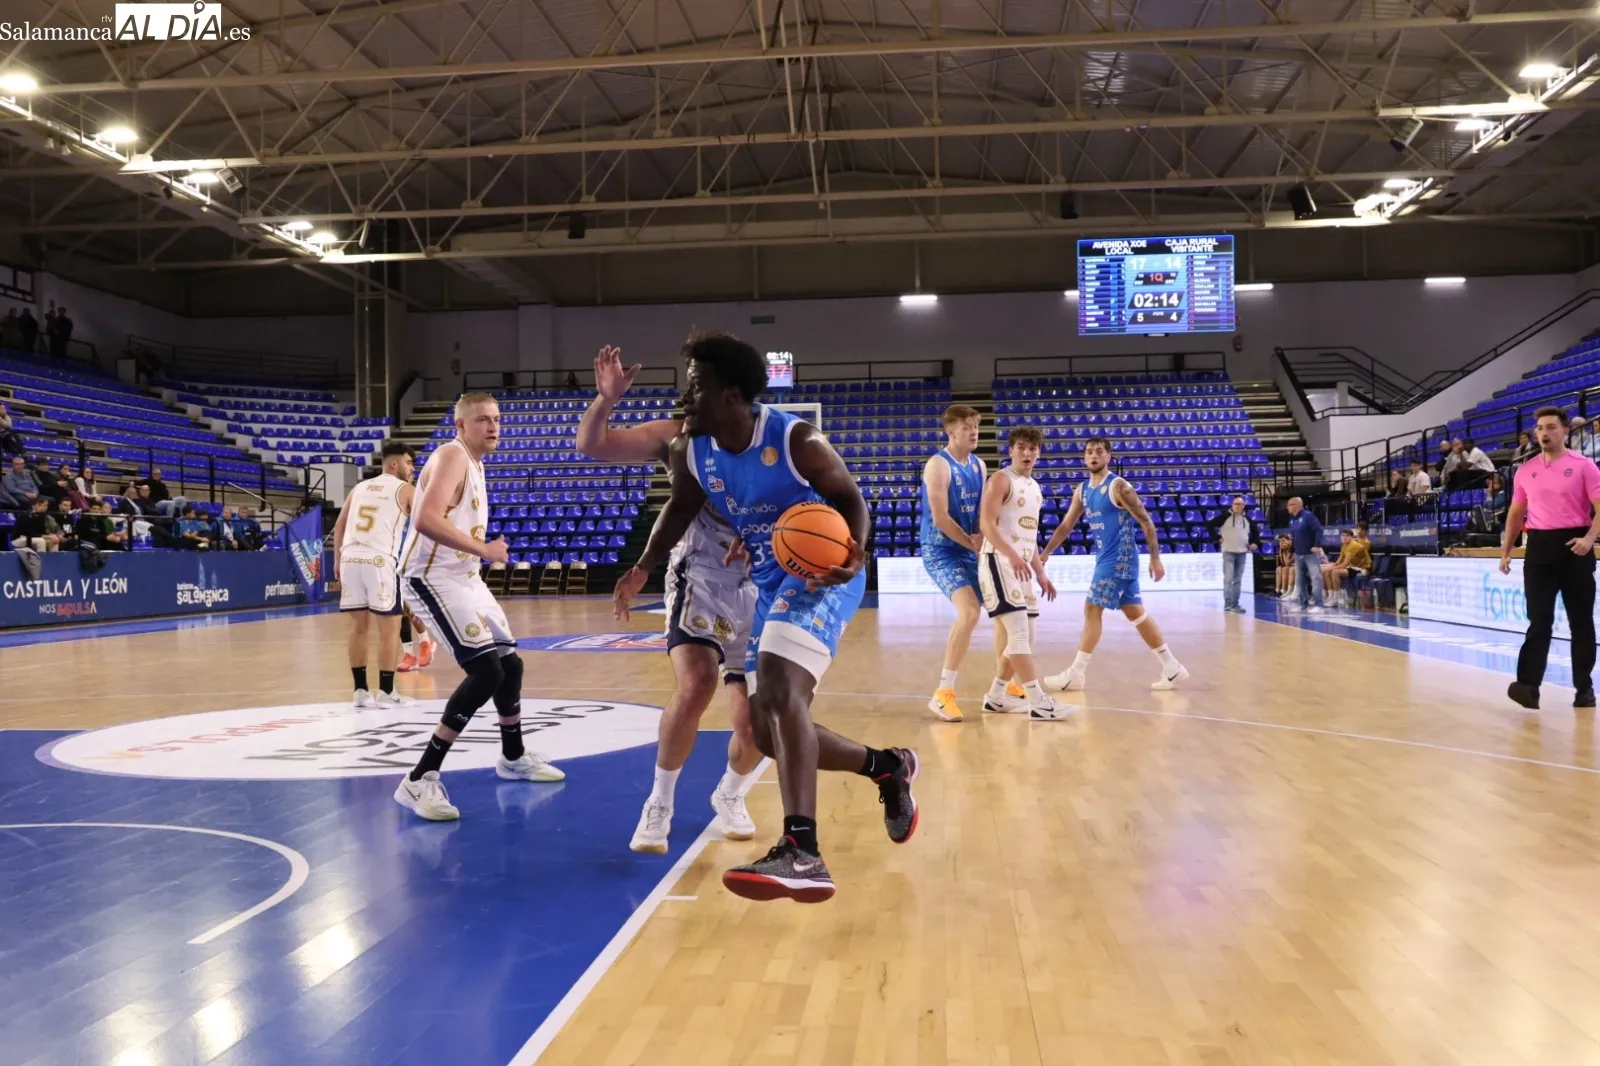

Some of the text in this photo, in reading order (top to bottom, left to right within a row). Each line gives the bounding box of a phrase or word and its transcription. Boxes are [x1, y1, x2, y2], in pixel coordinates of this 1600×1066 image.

[1092, 241, 1129, 249] AVENIDA
[1189, 237, 1219, 245] RURAL
[1105, 247, 1134, 255] LOCAL
[1171, 245, 1214, 253] VISITANTE
[1130, 257, 1147, 270] 17
[1165, 256, 1181, 269] 14
[1149, 272, 1163, 282] 1Q
[1134, 293, 1179, 307] 02:14
[1137, 312, 1144, 322] 5
[1170, 311, 1177, 321] 4
[355, 505, 378, 533] 5
[290, 542, 315, 586] AVENIDA
[3, 572, 128, 599] CASTILLA Y LEÓN
[39, 603, 56, 614] NOS
